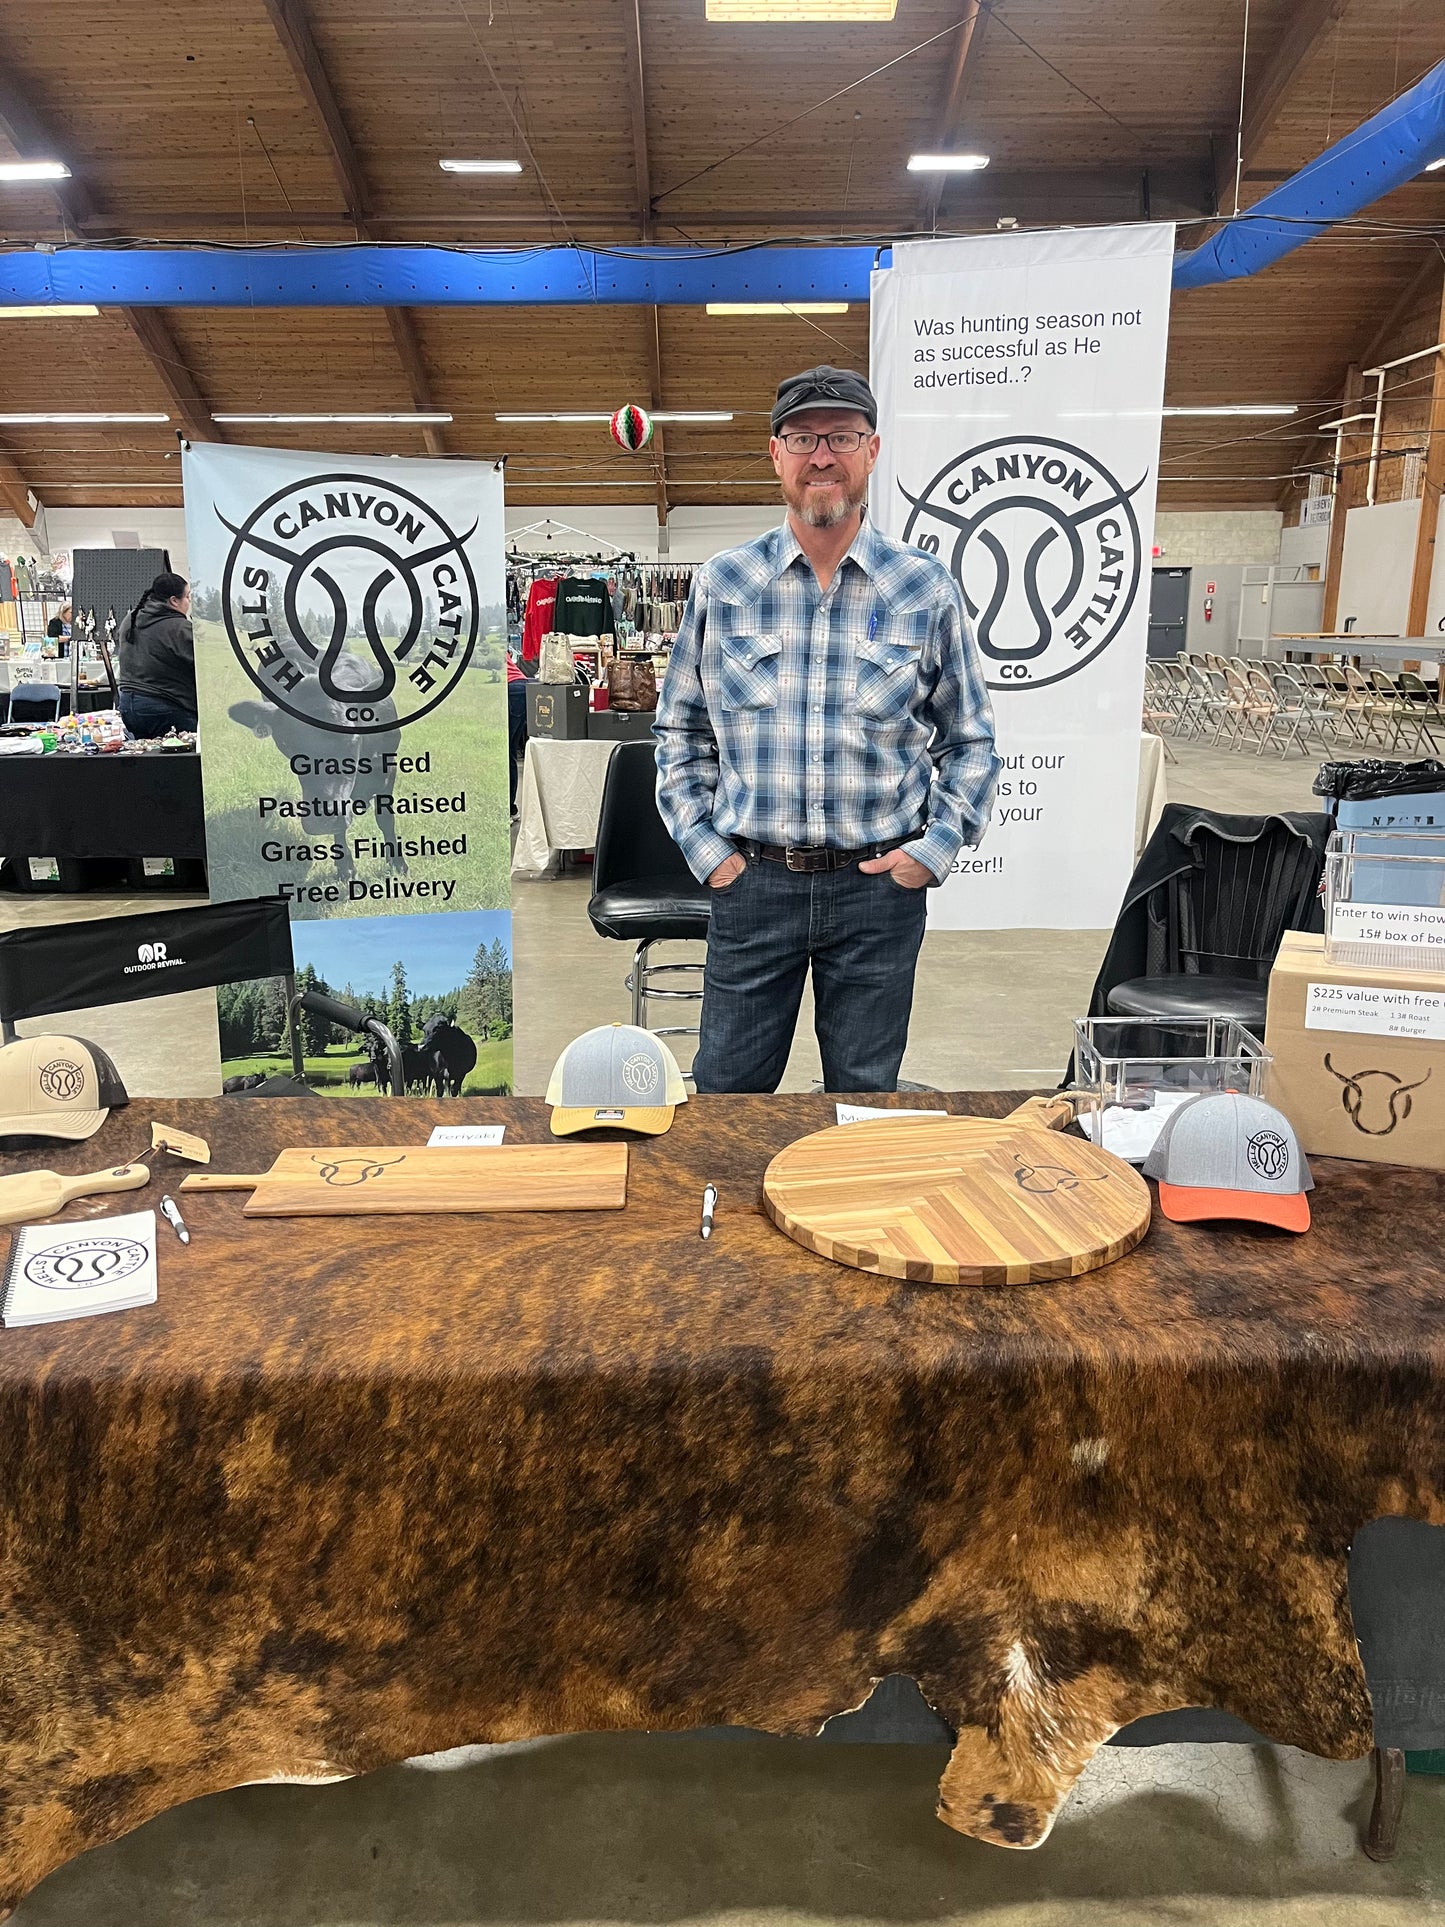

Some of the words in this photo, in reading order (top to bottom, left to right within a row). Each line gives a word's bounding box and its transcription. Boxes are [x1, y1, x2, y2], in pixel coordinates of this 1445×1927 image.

[914, 318, 955, 337] Was
[960, 314, 1029, 335] hunting
[1035, 311, 1104, 330] season
[1111, 308, 1142, 327] not
[913, 346, 935, 363] as
[941, 338, 1039, 361] successful
[1045, 340, 1067, 355] as
[1074, 336, 1101, 354] He
[913, 365, 1032, 388] advertised..?
[947, 454, 1093, 505] CANYON
[273, 492, 426, 545] CANYON
[1064, 518, 1124, 650] CATTLE
[242, 566, 305, 693] HELLS
[409, 563, 462, 694] CATTLE
[1000, 665, 1032, 679] CO.
[345, 707, 380, 722] CO.
[290, 753, 373, 776] Grass
[381, 752, 431, 774] Fed
[1031, 755, 1065, 769] our
[1019, 779, 1037, 796] to
[258, 796, 367, 818] Pasture
[376, 791, 467, 816] Raised
[999, 807, 1043, 826] your
[260, 840, 345, 863] Grass
[353, 834, 467, 860] Finished
[950, 856, 1003, 874] ezer!!
[278, 883, 339, 903] Free
[349, 878, 457, 902] Delivery
[1334, 906, 1368, 919] Enter
[1371, 909, 1384, 921] to
[1387, 910, 1410, 921] win
[1358, 928, 1382, 939] 15#
[1384, 930, 1407, 942] box
[1411, 932, 1425, 942] of
[123, 962, 156, 974] OUTDOOR
[1313, 987, 1343, 999] $225
[1346, 991, 1380, 1003] value
[1383, 994, 1410, 1006] with
[1414, 995, 1440, 1008] free
[1323, 1006, 1356, 1016] Premium
[1358, 1009, 1379, 1018] Steak
[1408, 1013, 1431, 1022] Roast
[1388, 1024, 1399, 1032] 8#
[1400, 1025, 1427, 1036] Burger
[437, 1132, 497, 1141] Teriyaki
[1256, 1133, 1281, 1144] CANYON
[52, 1240, 124, 1255] CANYON
[111, 1248, 141, 1276] CATTLE
